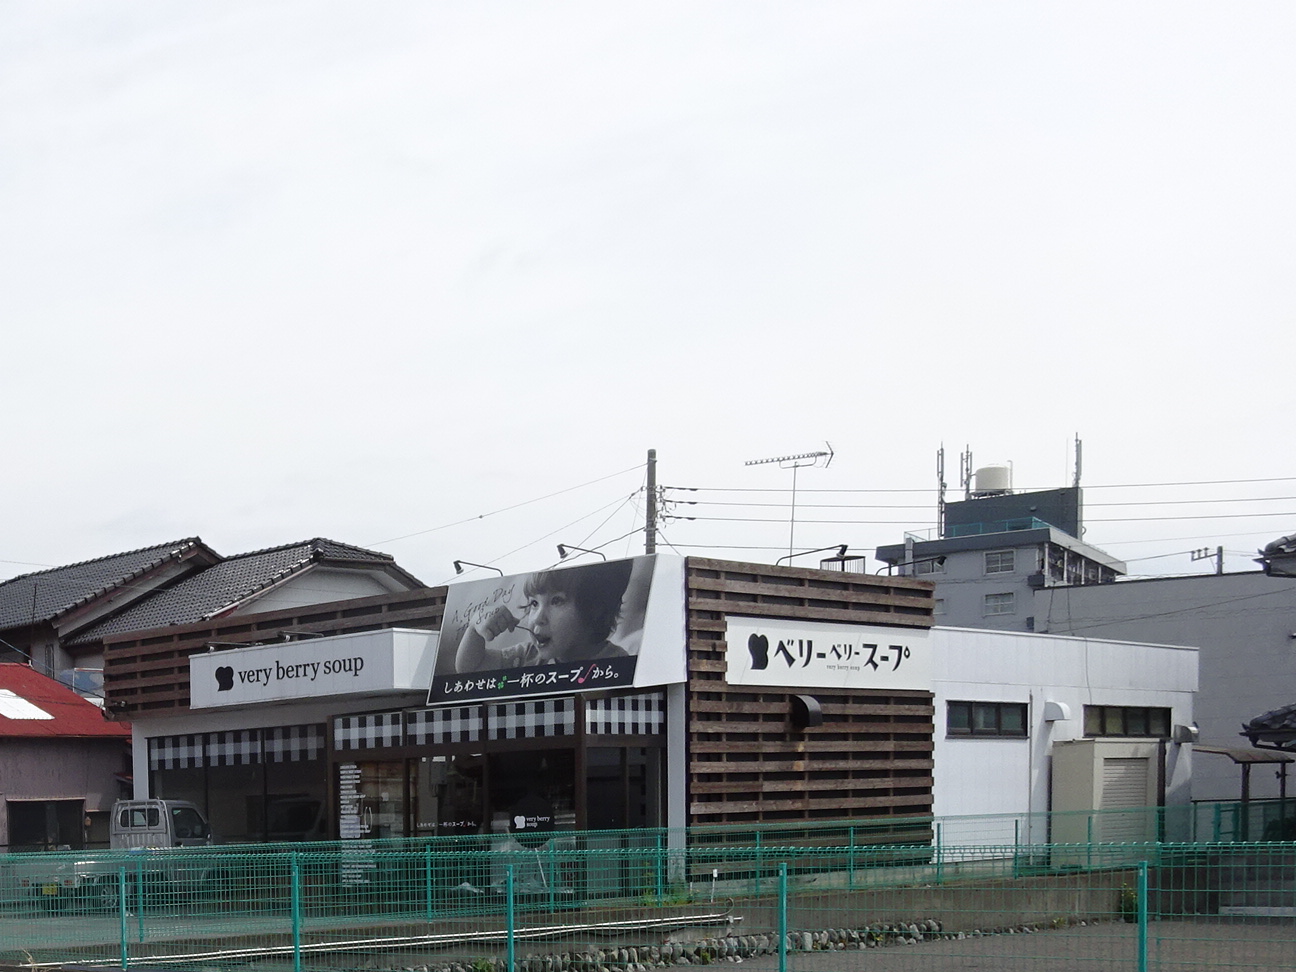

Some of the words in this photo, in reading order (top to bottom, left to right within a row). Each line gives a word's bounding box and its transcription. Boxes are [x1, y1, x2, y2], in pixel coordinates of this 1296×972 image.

[463, 596, 489, 621] Good
[492, 583, 515, 603] Day
[238, 667, 273, 686] very
[275, 660, 320, 681] berry
[323, 655, 364, 676] soup
[773, 639, 911, 672] ベリーベリースープ
